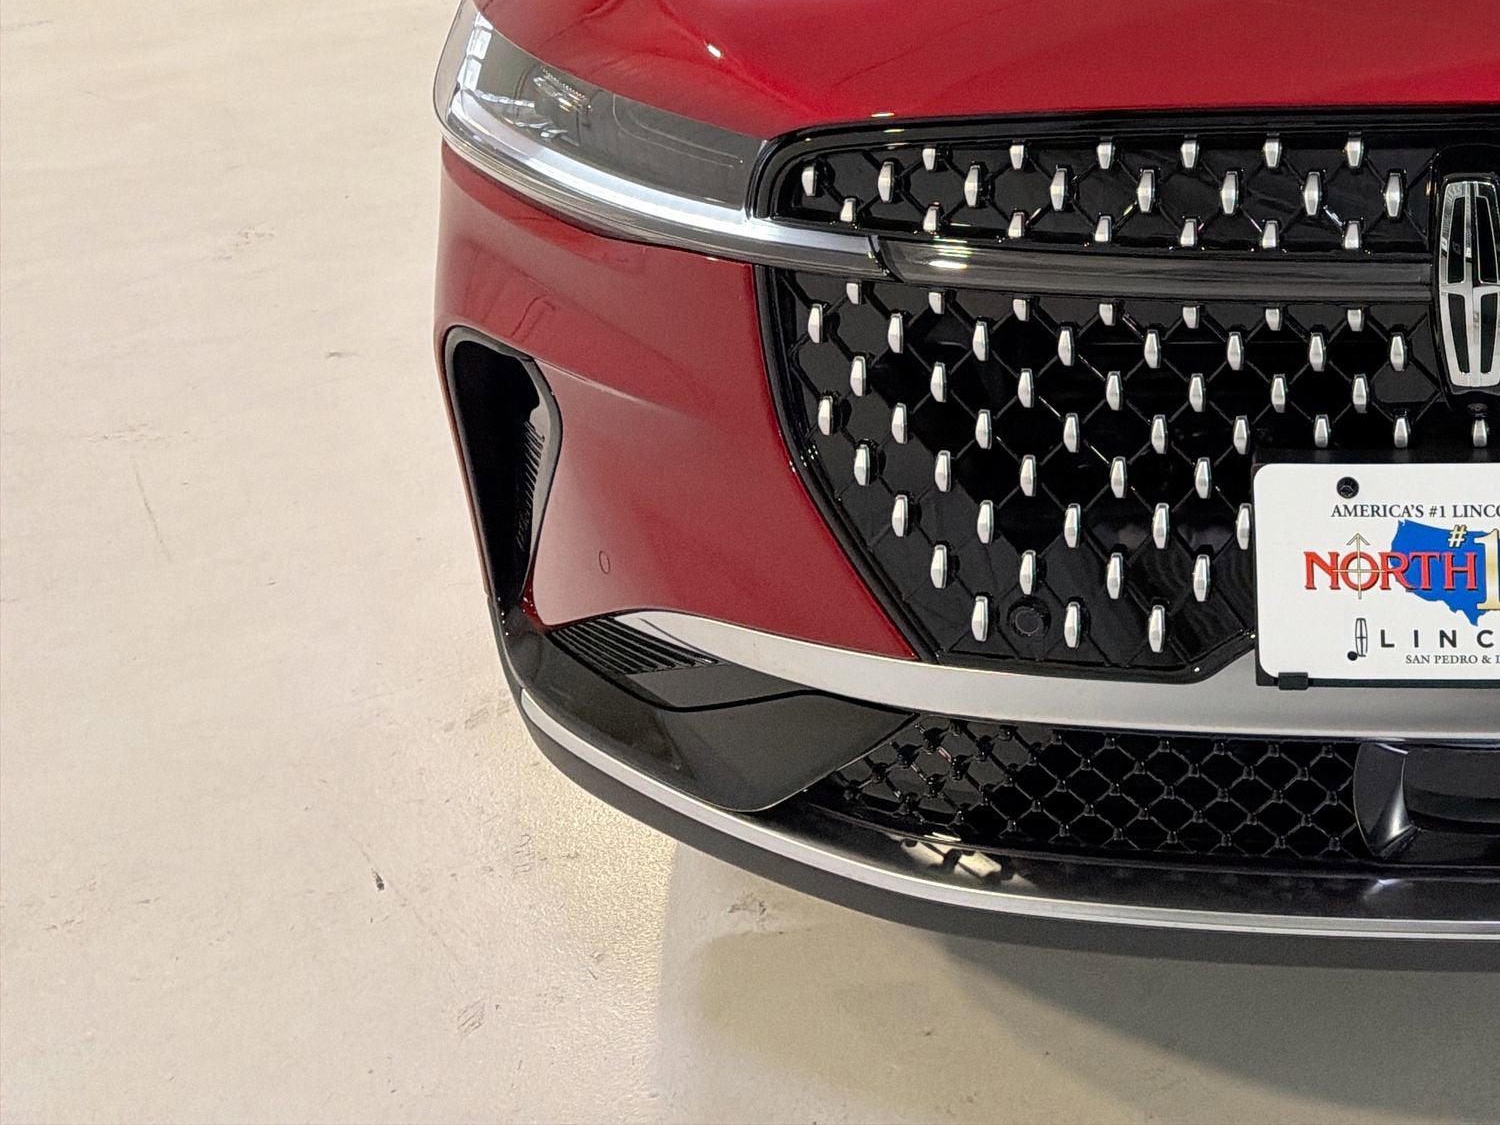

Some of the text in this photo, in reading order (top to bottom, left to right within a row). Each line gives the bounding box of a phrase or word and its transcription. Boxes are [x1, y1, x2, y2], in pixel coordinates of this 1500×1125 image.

[1331, 503, 1424, 518] AMERICA'S
[1428, 505, 1446, 518] #1
[1303, 550, 1477, 592] NORTH
[1405, 654, 1431, 665] SAN
[1434, 654, 1478, 665] PEDRO
[1481, 654, 1492, 665] &
